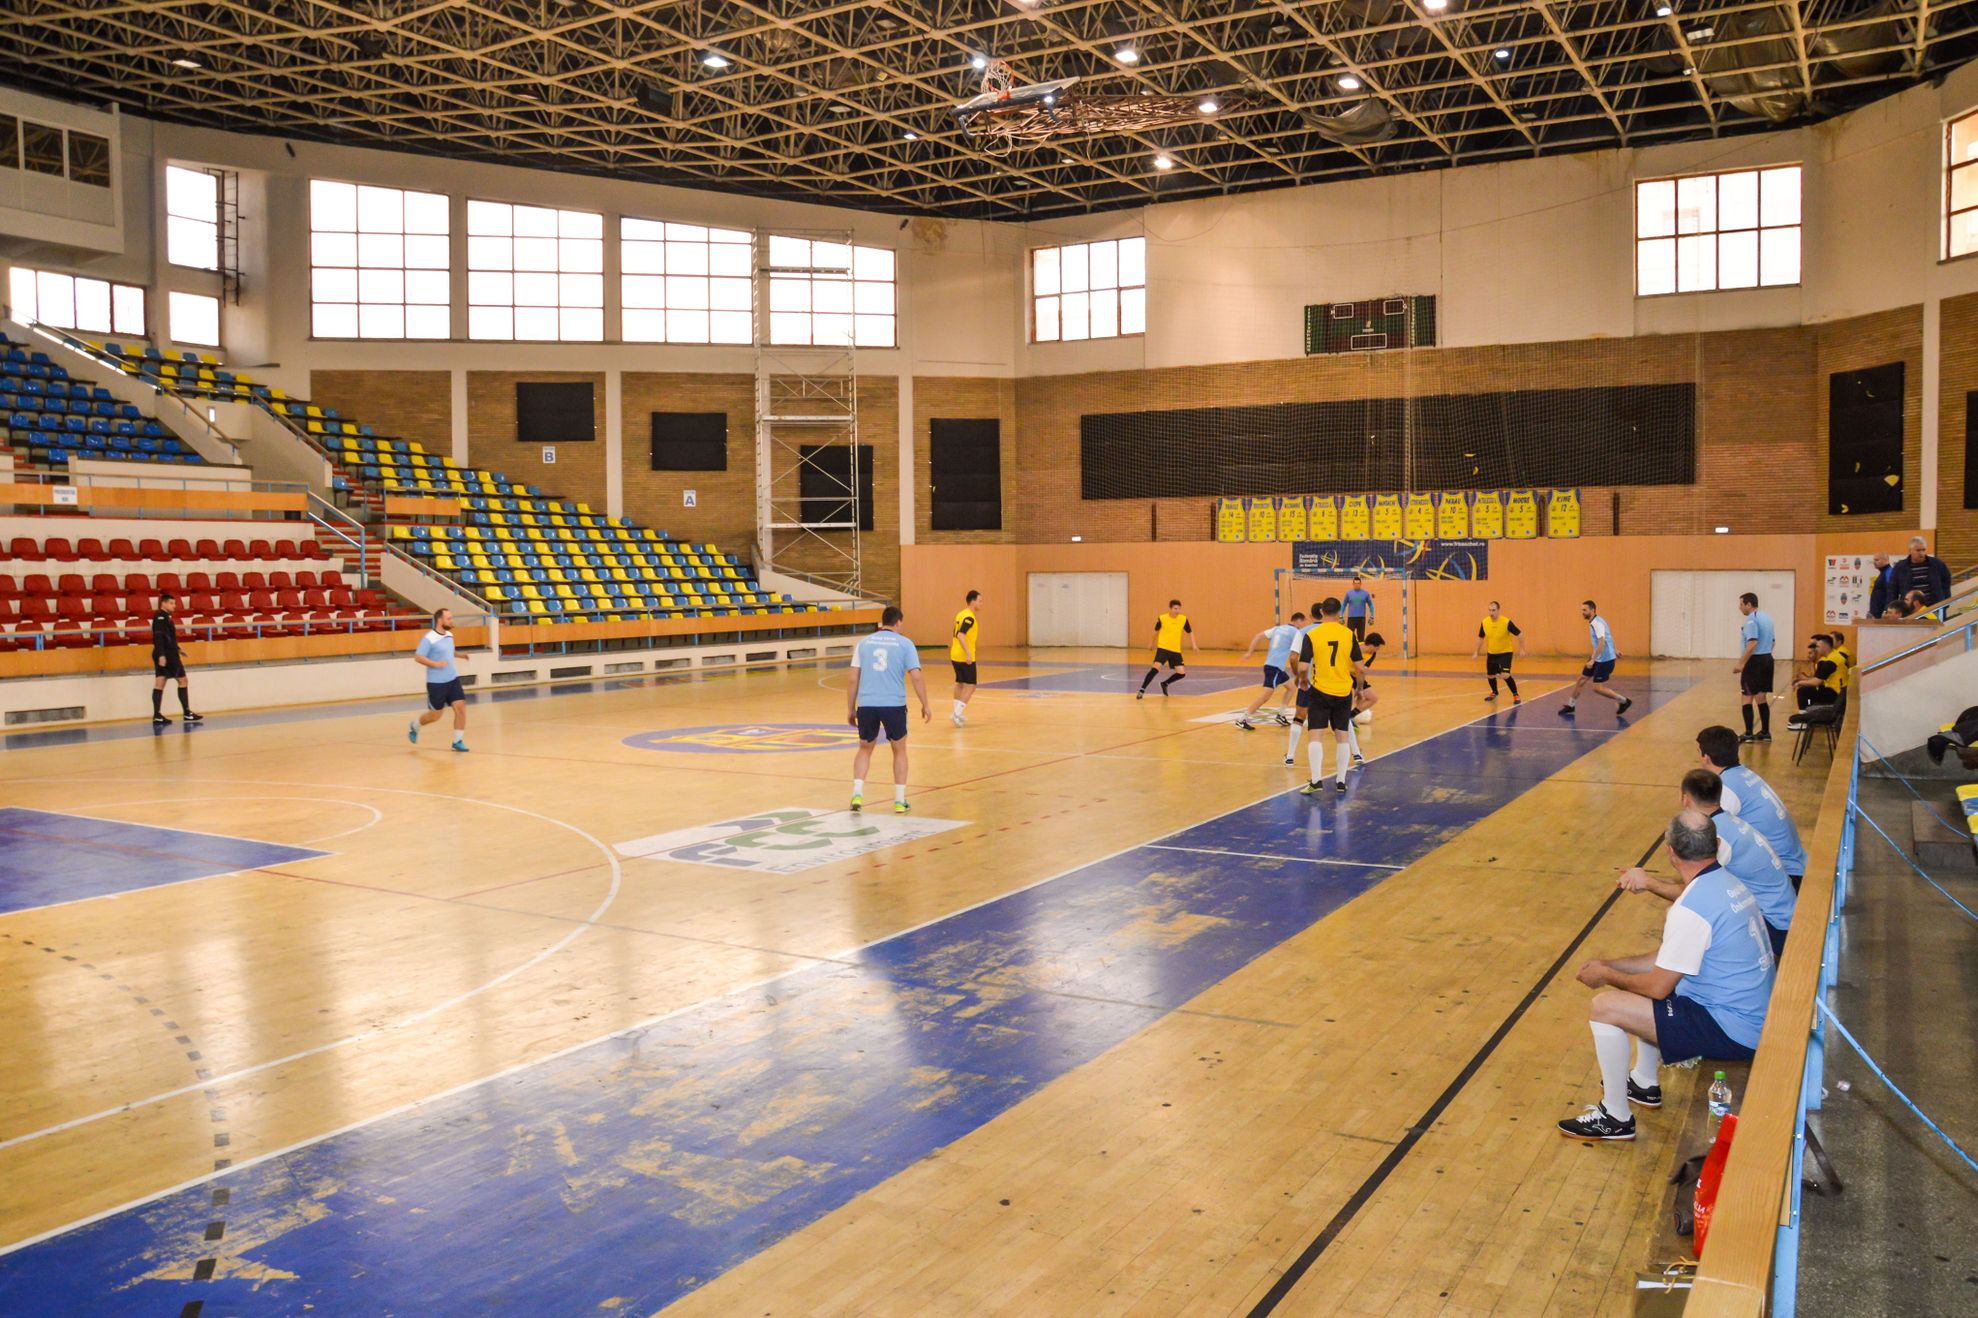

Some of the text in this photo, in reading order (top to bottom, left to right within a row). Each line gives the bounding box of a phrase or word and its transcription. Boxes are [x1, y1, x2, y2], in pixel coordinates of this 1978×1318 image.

[544, 451, 554, 462] B
[685, 495, 695, 505] A
[1450, 506, 1456, 514] 10
[1560, 504, 1567, 512] 12
[1327, 640, 1339, 667] 7
[872, 648, 889, 673] 3
